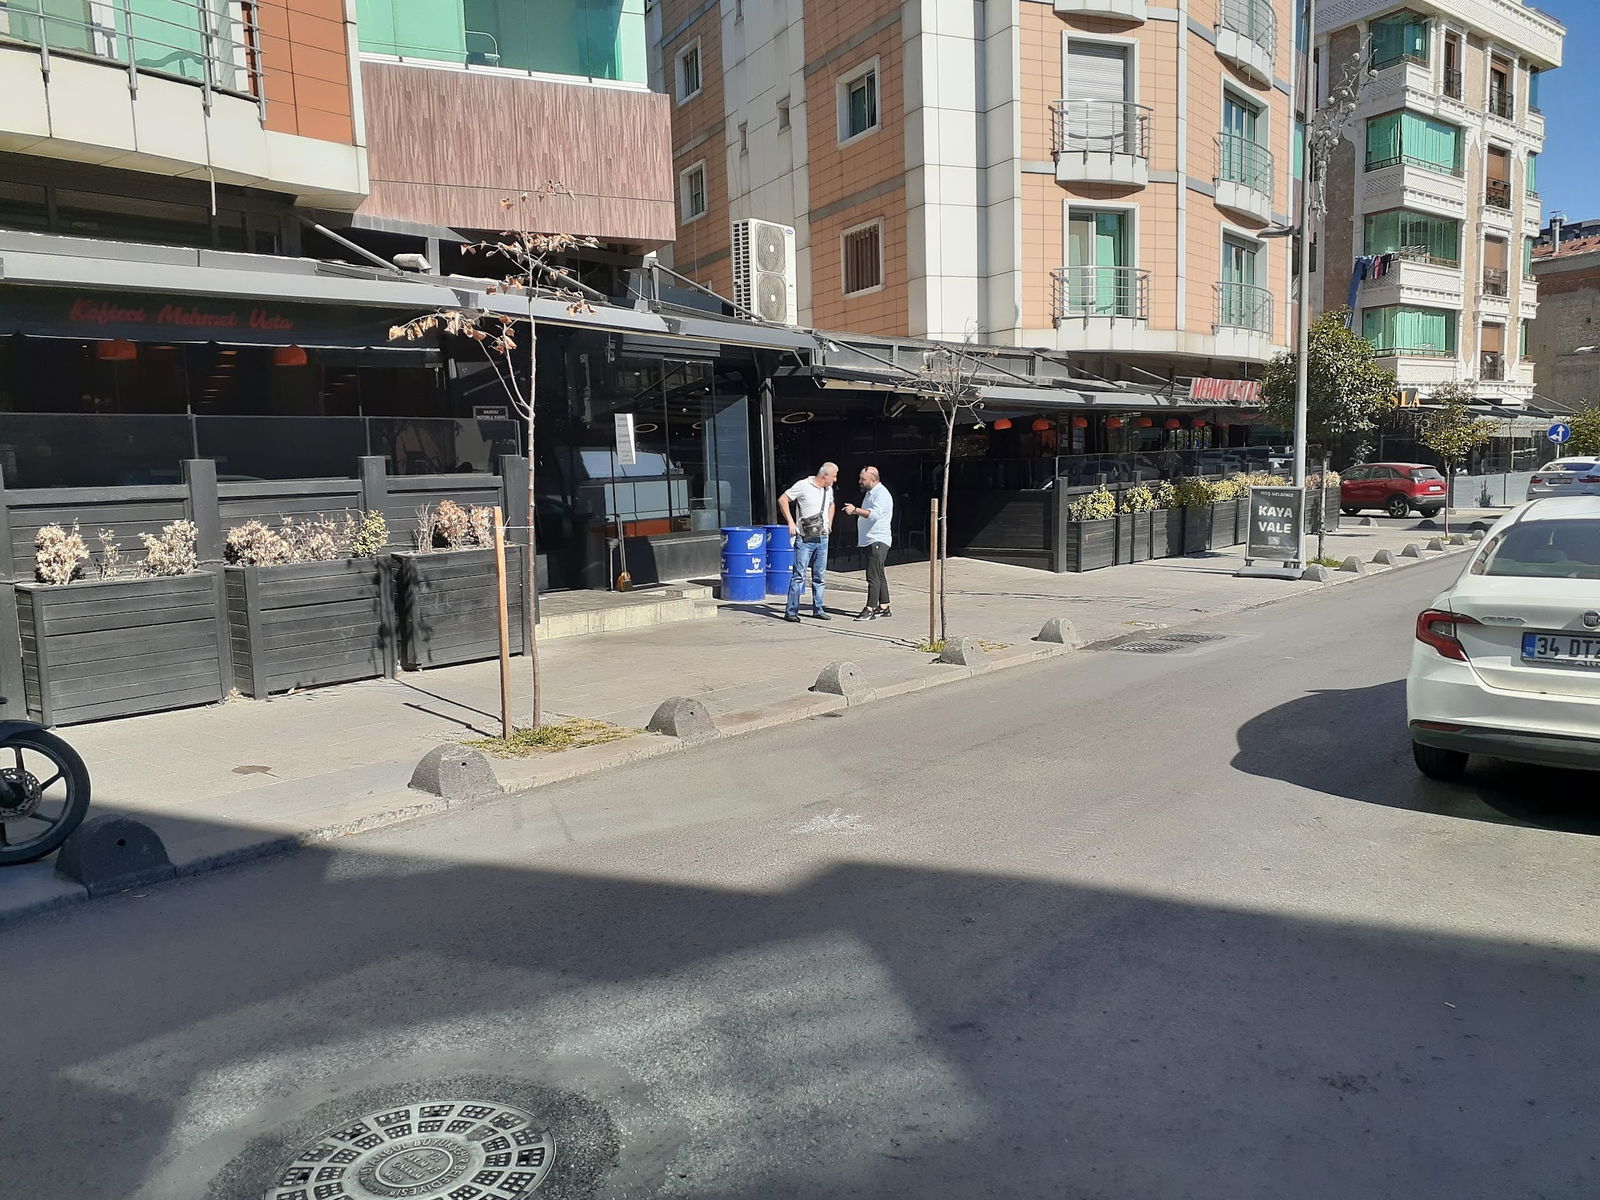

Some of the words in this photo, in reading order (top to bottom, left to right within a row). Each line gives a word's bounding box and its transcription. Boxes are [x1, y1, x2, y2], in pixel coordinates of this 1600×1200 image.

[158, 303, 239, 327] Mehmet
[248, 307, 294, 330] Usta
[1258, 505, 1293, 518] KAYA
[1257, 521, 1292, 534] VALE
[1537, 636, 1560, 657] 34
